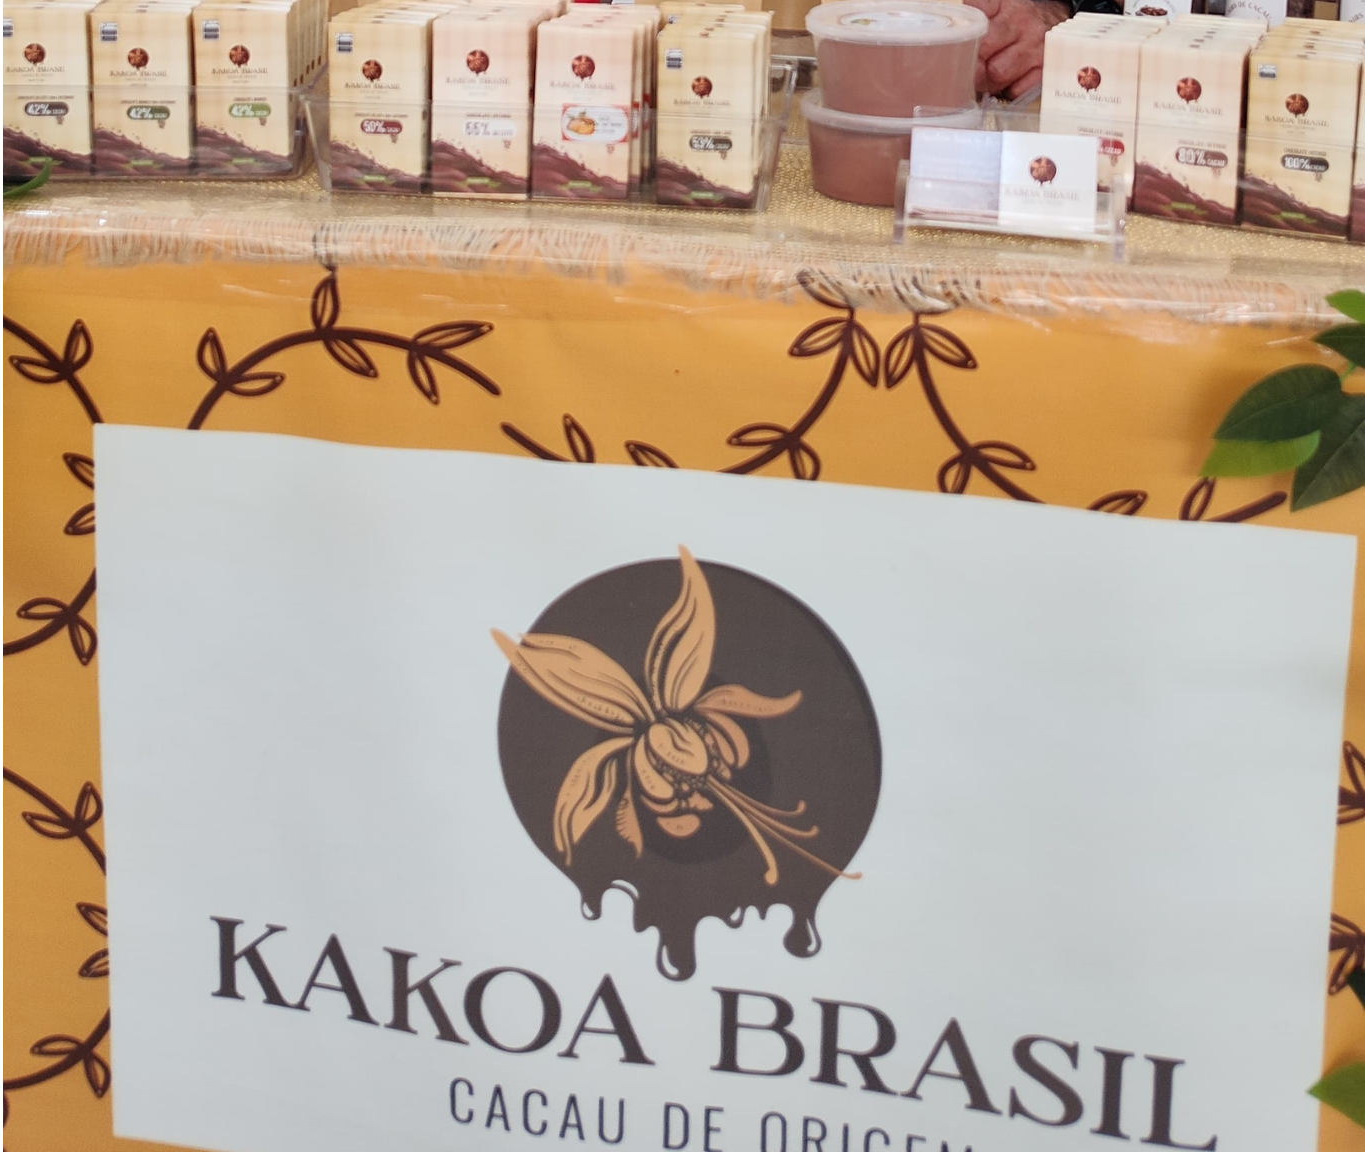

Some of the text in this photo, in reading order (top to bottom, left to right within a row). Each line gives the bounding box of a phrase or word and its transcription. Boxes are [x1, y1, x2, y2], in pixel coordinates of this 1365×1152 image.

[1283, 156, 1311, 170] 100%
[208, 914, 1220, 1152] KAKOA BRASIL
[448, 1075, 628, 1147] CACAU
[662, 1101, 726, 1152] DE
